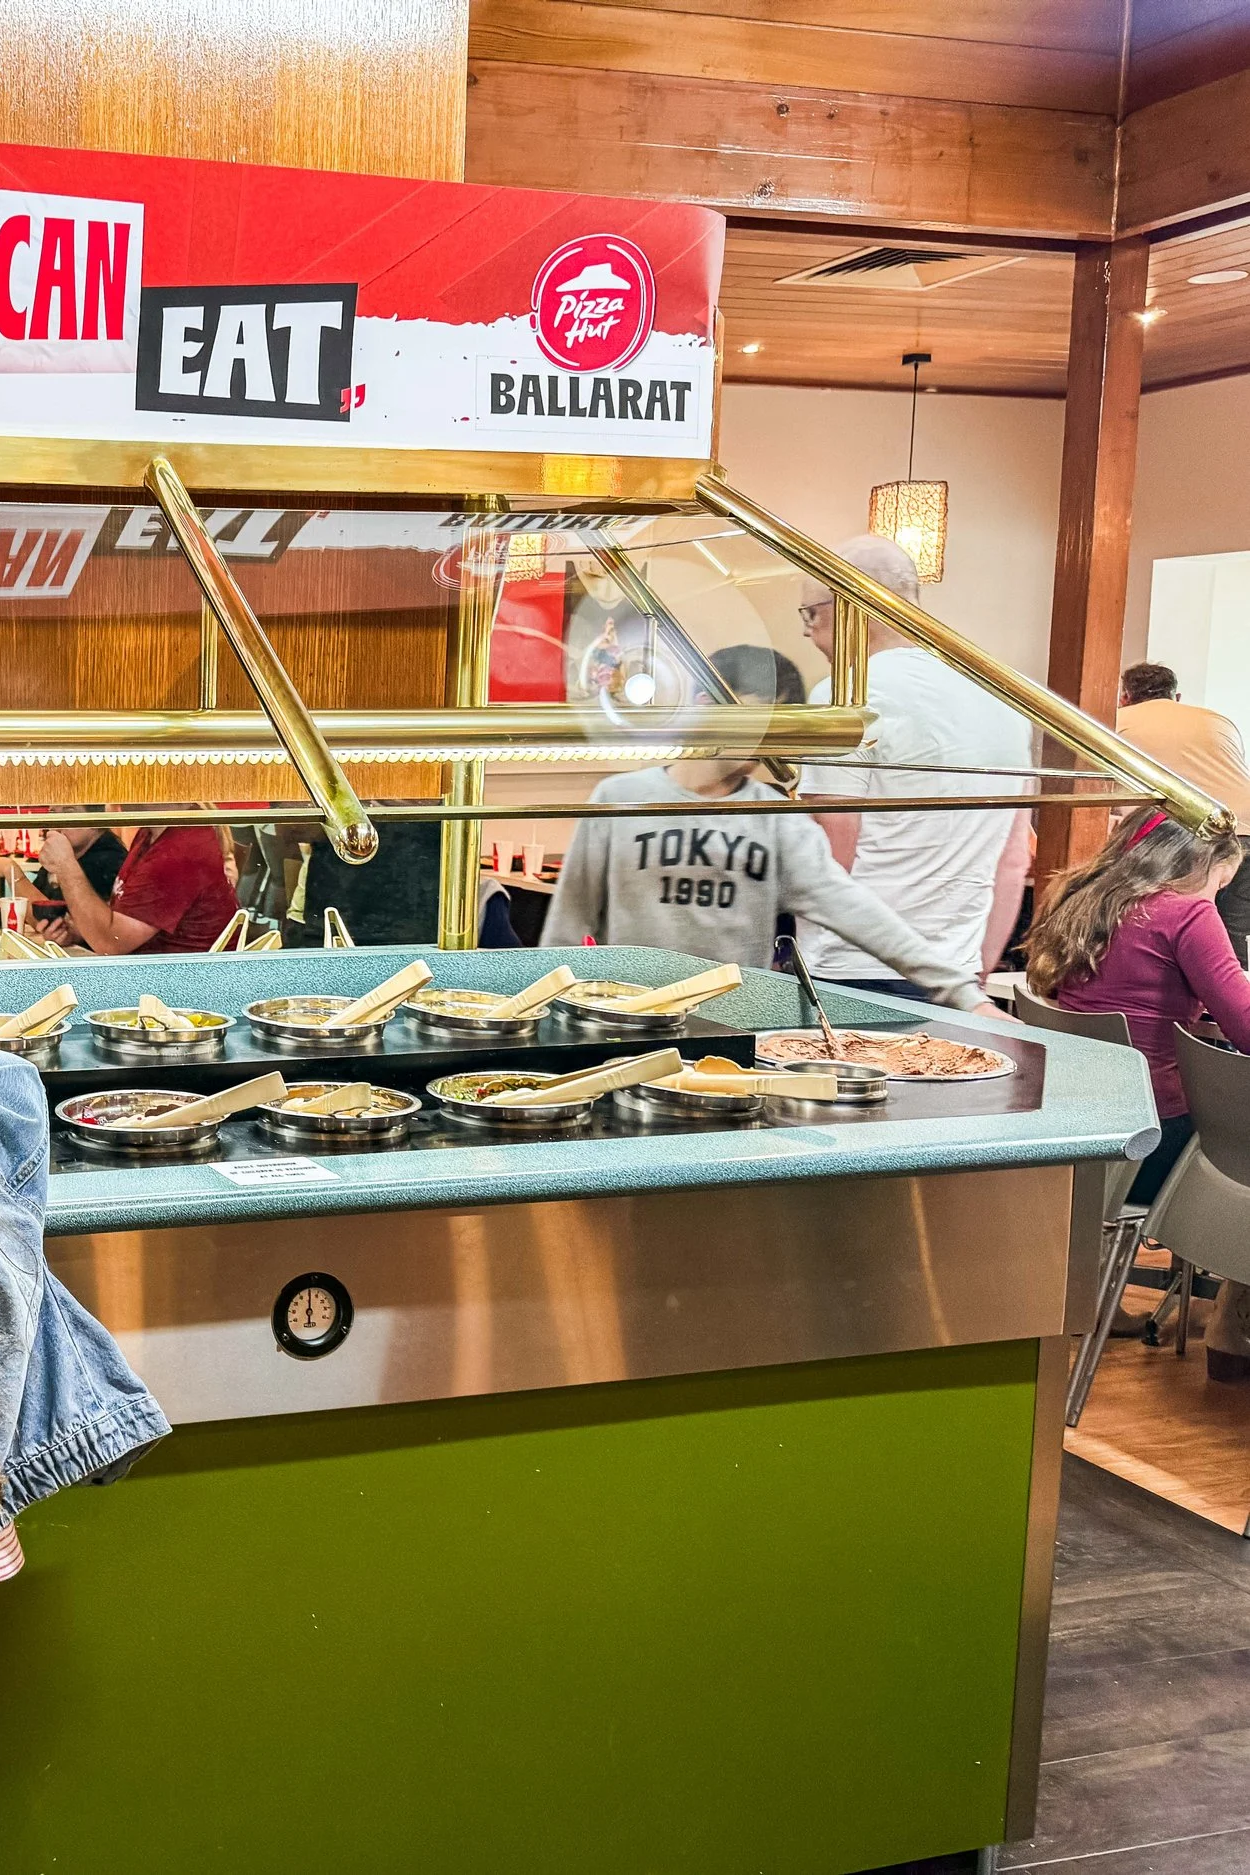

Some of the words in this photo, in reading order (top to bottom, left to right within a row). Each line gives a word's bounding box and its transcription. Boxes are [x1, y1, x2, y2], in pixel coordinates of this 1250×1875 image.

[553, 290, 625, 328] Pizza
[564, 315, 621, 348] Hut
[490, 373, 692, 421] BALLARAT
[635, 828, 769, 881] TOKYO
[659, 876, 736, 908] 1990
